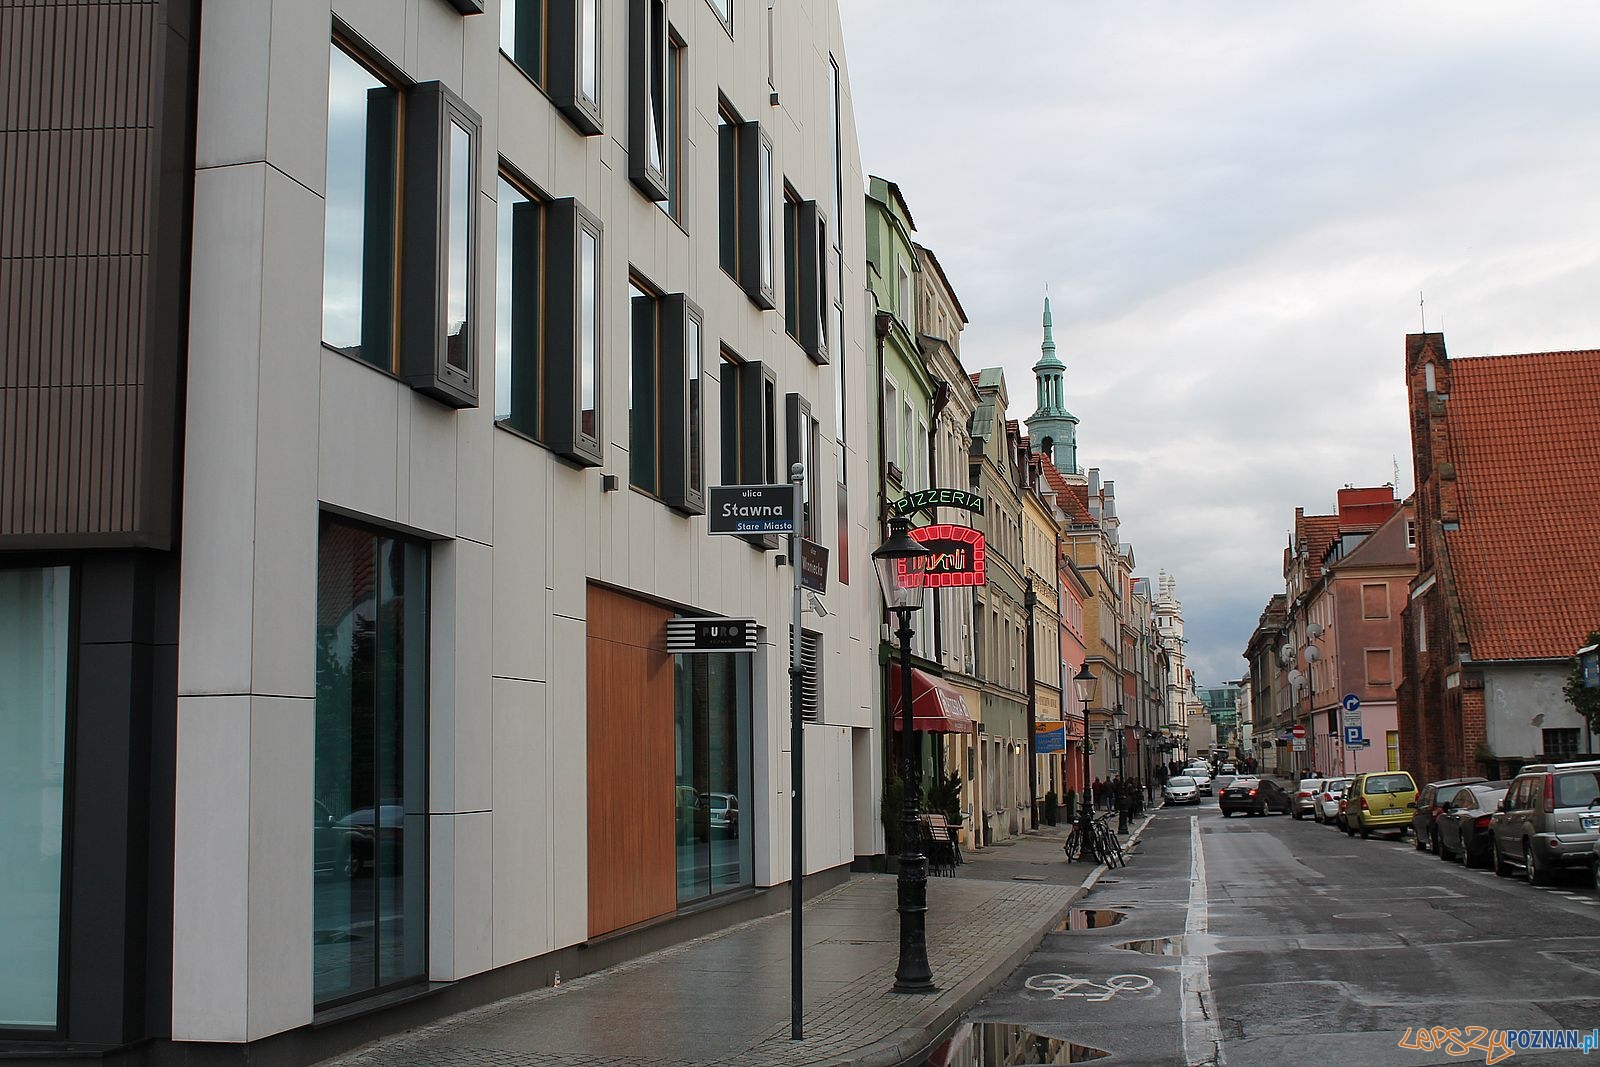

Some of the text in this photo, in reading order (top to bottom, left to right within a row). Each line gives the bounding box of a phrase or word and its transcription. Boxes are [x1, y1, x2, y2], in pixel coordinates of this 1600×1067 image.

[742, 489, 763, 498] ulica
[897, 490, 981, 513] PIZZERIA
[722, 502, 784, 518] Stawna
[737, 521, 793, 532] Stare Miasto
[702, 626, 739, 638] PURO
